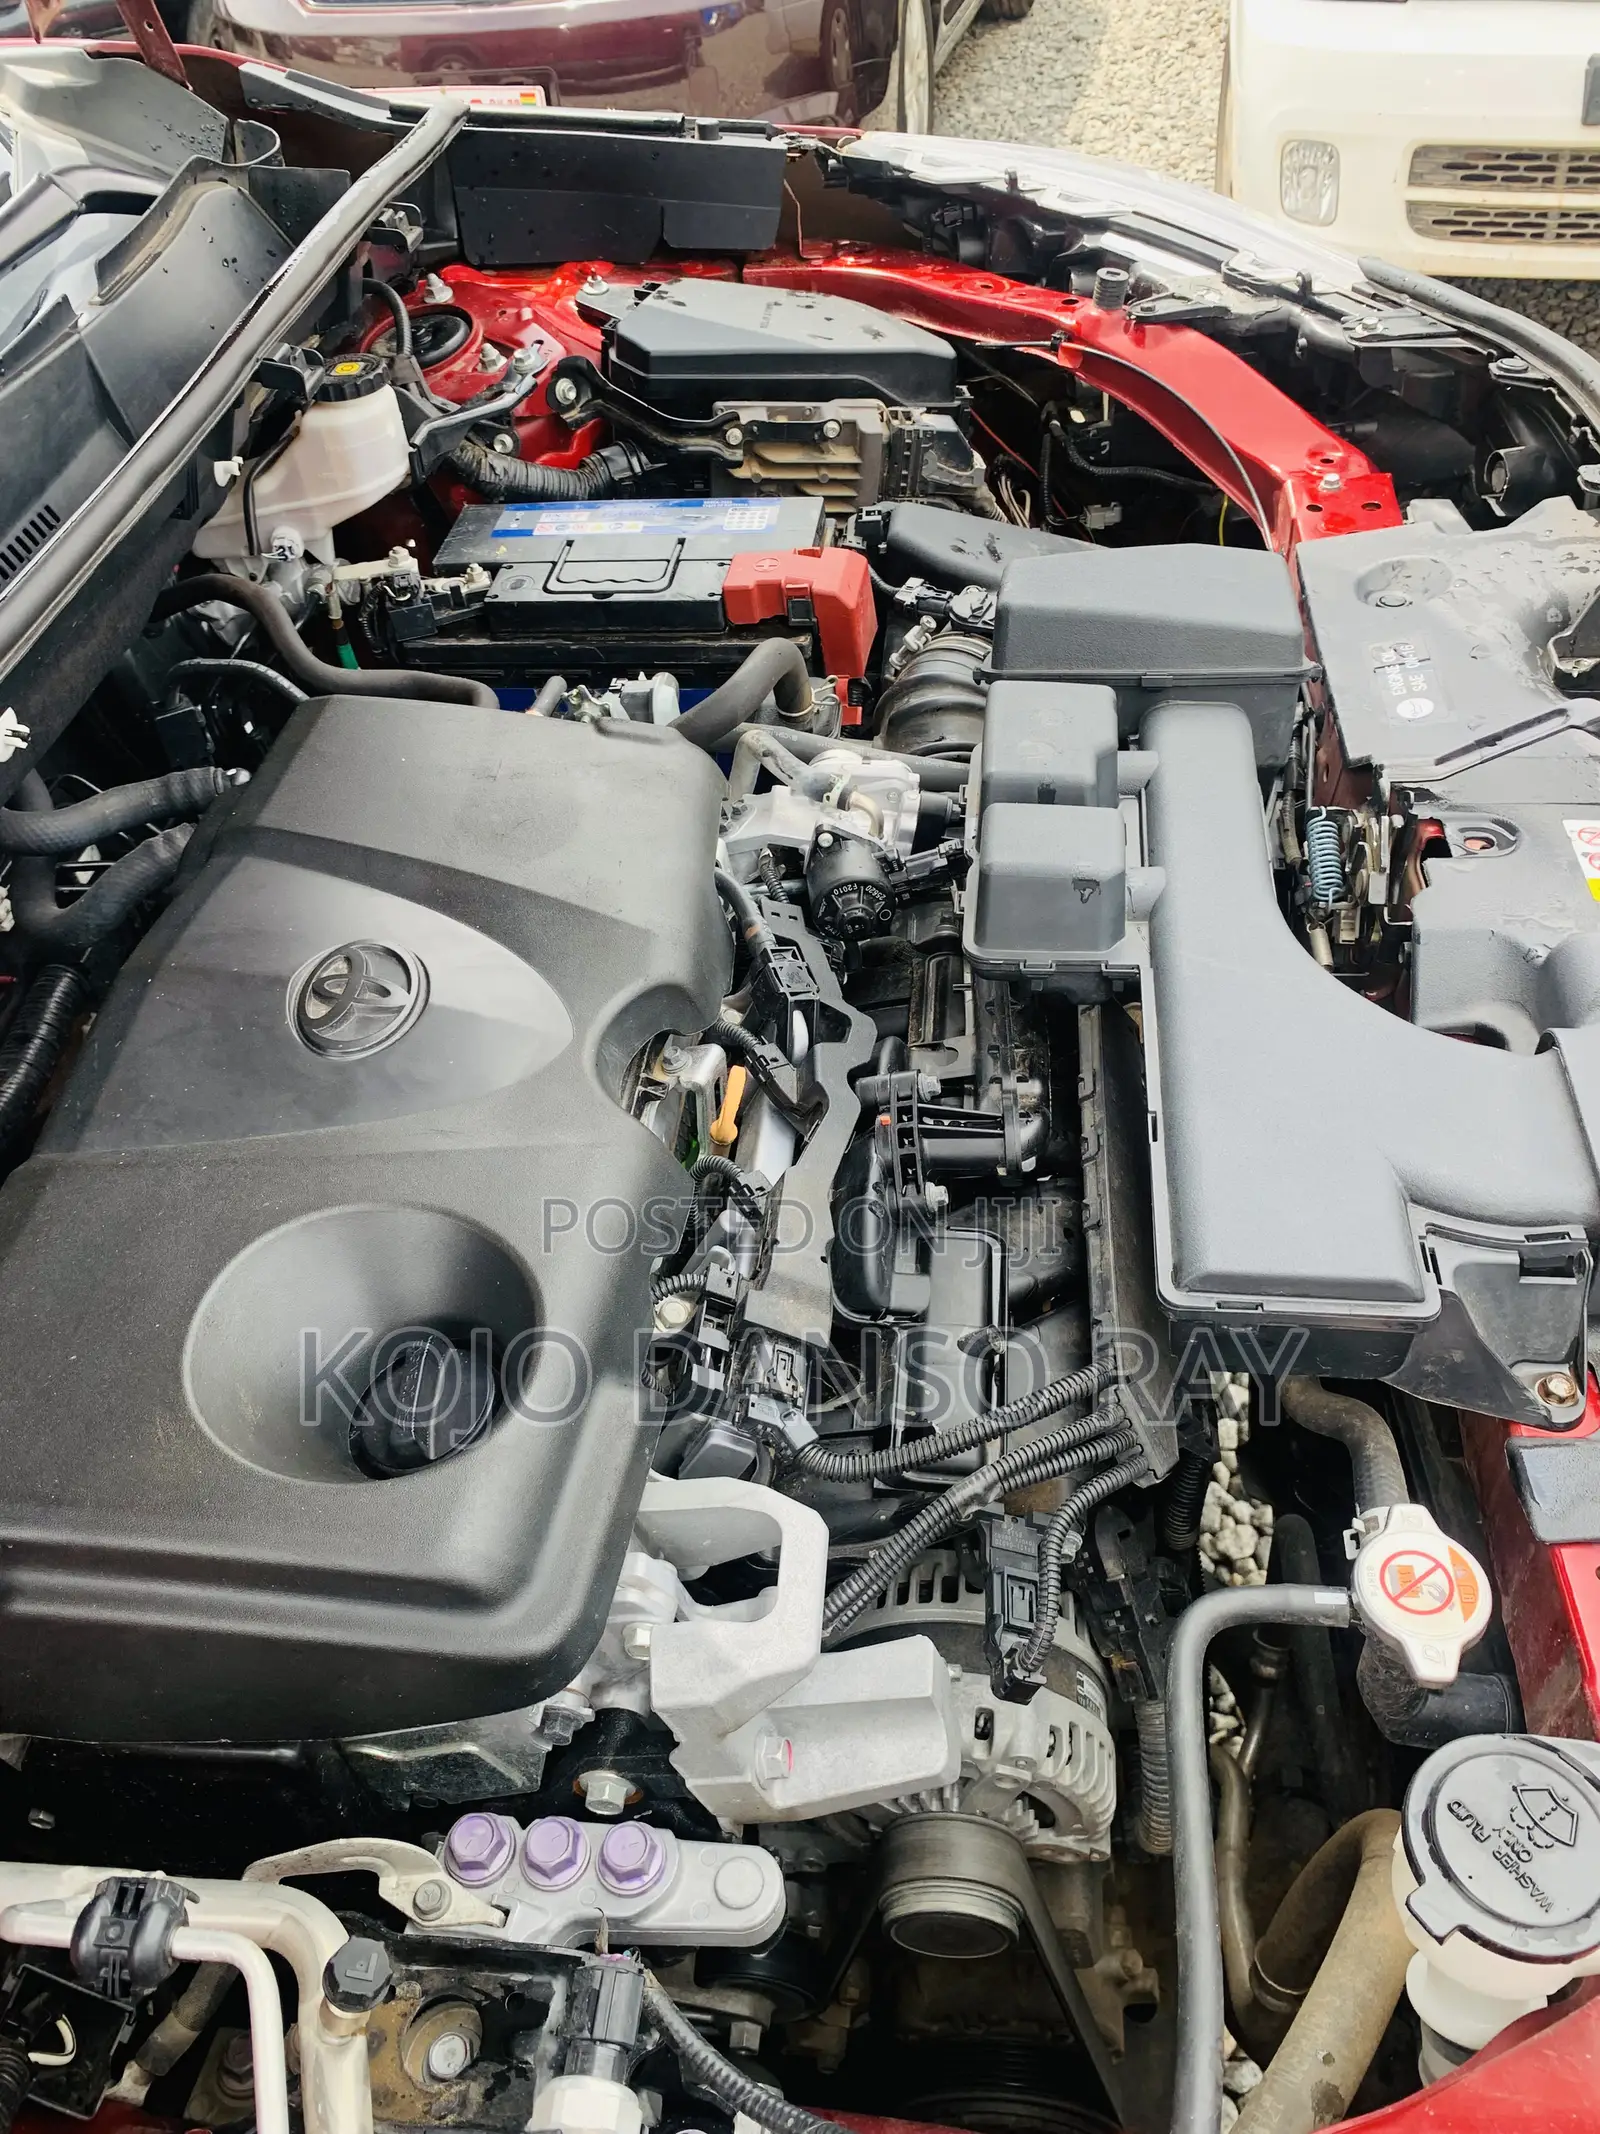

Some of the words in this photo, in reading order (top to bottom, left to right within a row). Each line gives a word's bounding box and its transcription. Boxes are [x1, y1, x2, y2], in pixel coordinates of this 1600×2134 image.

[1384, 664, 1408, 696] ENGINE
[1408, 673, 1428, 692] SAE
[833, 882, 859, 896] F2010
[865, 884, 887, 901] 25620
[1447, 1800, 1491, 1843] FLUID
[1492, 1826, 1533, 1863] ONLY
[1492, 1847, 1554, 1913] WASHER
